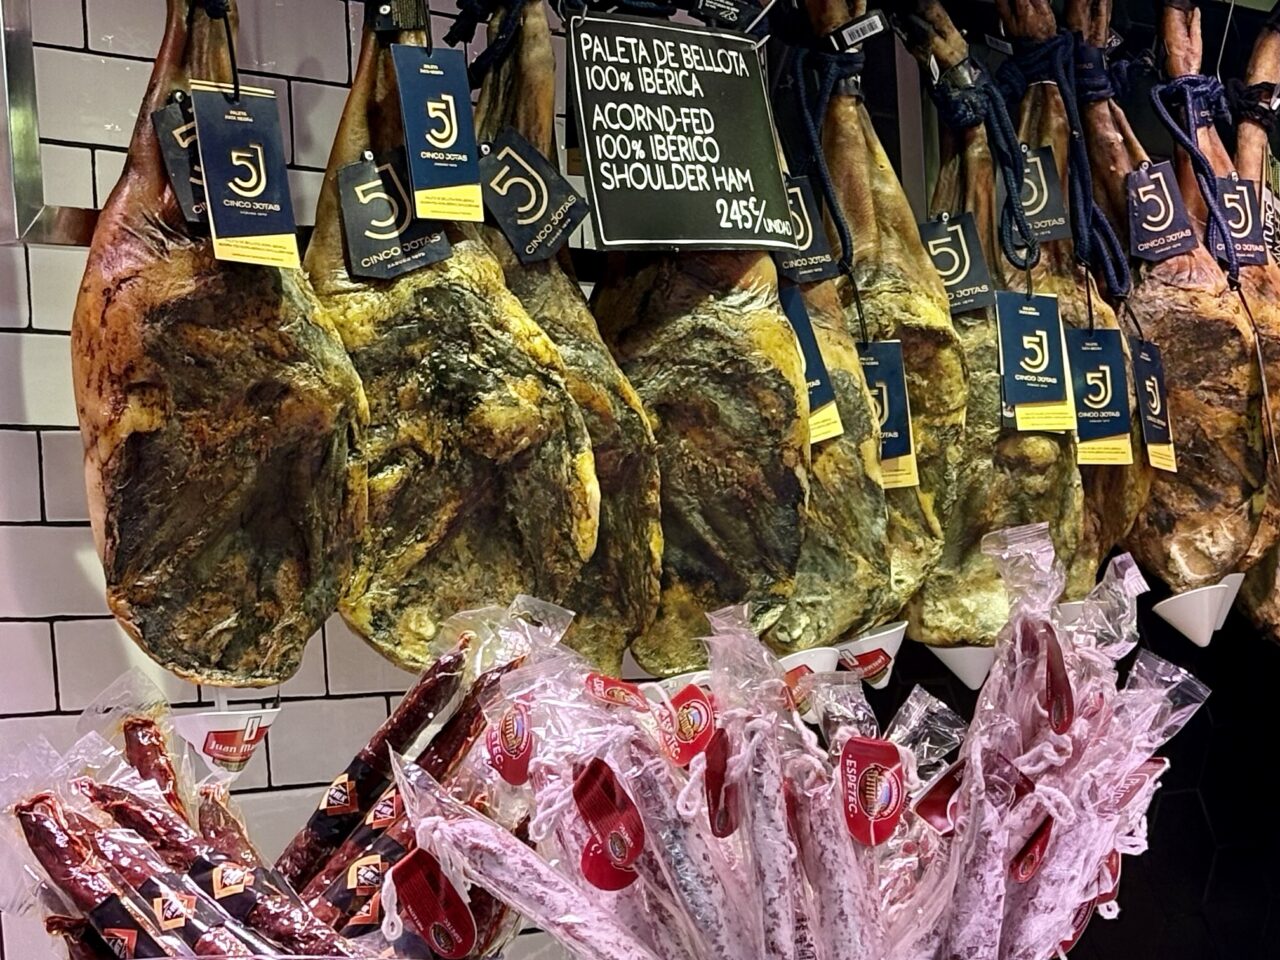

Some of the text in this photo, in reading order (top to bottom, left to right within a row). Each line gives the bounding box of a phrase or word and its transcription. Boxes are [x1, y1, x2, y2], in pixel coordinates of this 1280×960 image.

[580, 33, 750, 77] PALETA DE BELLOTA
[585, 64, 704, 98] 100% IBÉRICA
[425, 94, 458, 149] 5J
[421, 151, 467, 162] CINCO JOTAS
[595, 131, 720, 163] 100% IBÉRICO
[227, 143, 267, 198] 5J
[490, 147, 548, 225] 5J
[600, 162, 754, 192] SHOULDER HAM
[223, 199, 281, 212] CINCO JOTAS
[354, 163, 412, 239] 5J
[1138, 172, 1174, 232] 5J
[1223, 186, 1252, 238] 5J
[525, 195, 576, 255] CINCO JOTAS
[1034, 217, 1066, 229] JOTAS
[1138, 229, 1192, 251] CINCO JOTAS
[361, 233, 441, 267] CINCO JOTAS
[782, 254, 832, 269] CINCO JOTAS
[928, 224, 970, 286] 5J
[1243, 243, 1265, 252] JOTAS
[956, 284, 989, 297] JOTAS
[1020, 330, 1049, 373] 5J
[1014, 374, 1057, 384] CINCO JOTAS
[1083, 365, 1112, 409] 5J
[1145, 376, 1161, 415] 5J
[209, 741, 236, 752] Juan
